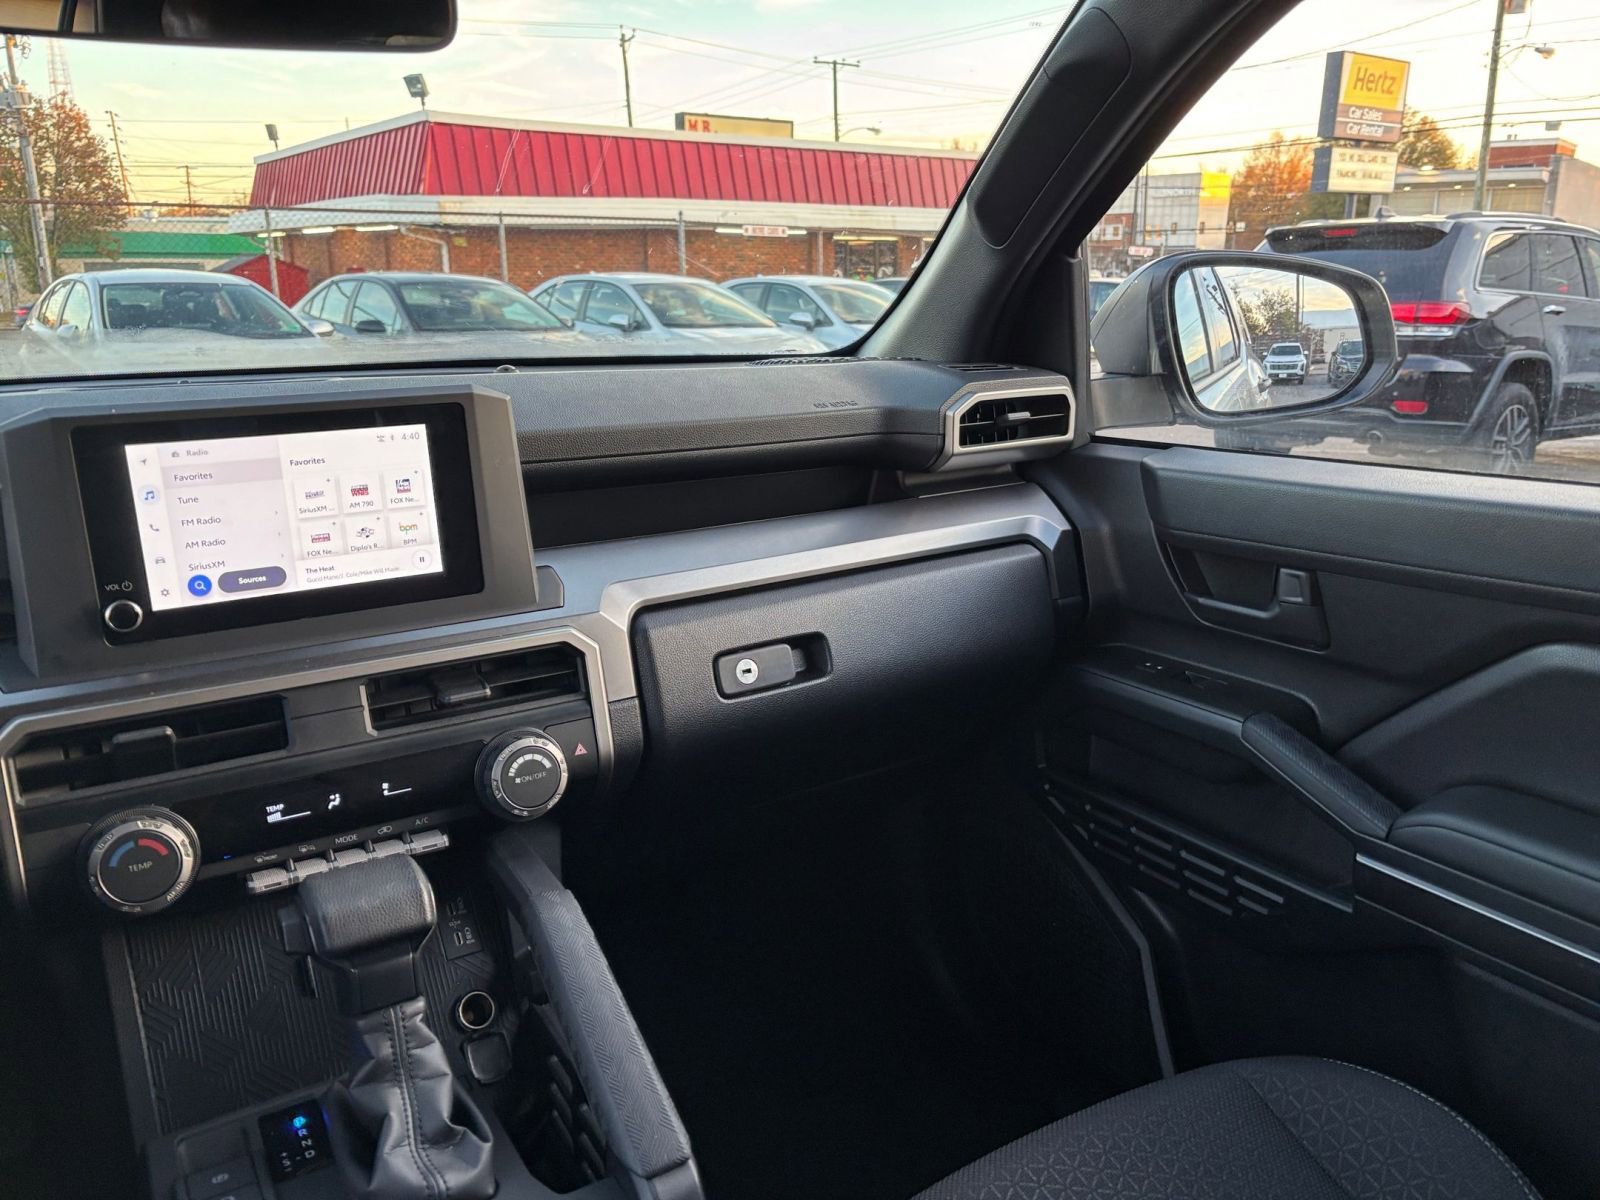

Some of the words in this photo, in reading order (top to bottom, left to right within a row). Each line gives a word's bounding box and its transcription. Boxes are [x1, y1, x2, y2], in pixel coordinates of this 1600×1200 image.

[1353, 66, 1397, 95] Hertz
[1349, 107, 1361, 118] Car
[1362, 108, 1383, 121] Sales
[1346, 123, 1360, 135] Car
[401, 432, 420, 440] 4:40
[186, 449, 209, 457] Radio
[290, 457, 326, 466] Favorites
[174, 472, 213, 482] Favorites
[178, 496, 199, 505] Tune
[362, 500, 374, 508] 790
[299, 505, 328, 514] SiriusXM
[181, 519, 195, 527] FM
[196, 516, 222, 526] Radio
[185, 541, 200, 549] AM
[201, 538, 226, 547] Radio
[188, 560, 226, 571] SiriusXM
[306, 567, 320, 575] The
[321, 565, 335, 573] Heat
[238, 575, 267, 585] Sources
[520, 771, 547, 783] ON/OFF
[265, 803, 284, 813] TEMP
[415, 816, 429, 826] A/C
[335, 833, 359, 844] MODE
[128, 861, 153, 872] TEMP
[304, 1150, 315, 1159] D
